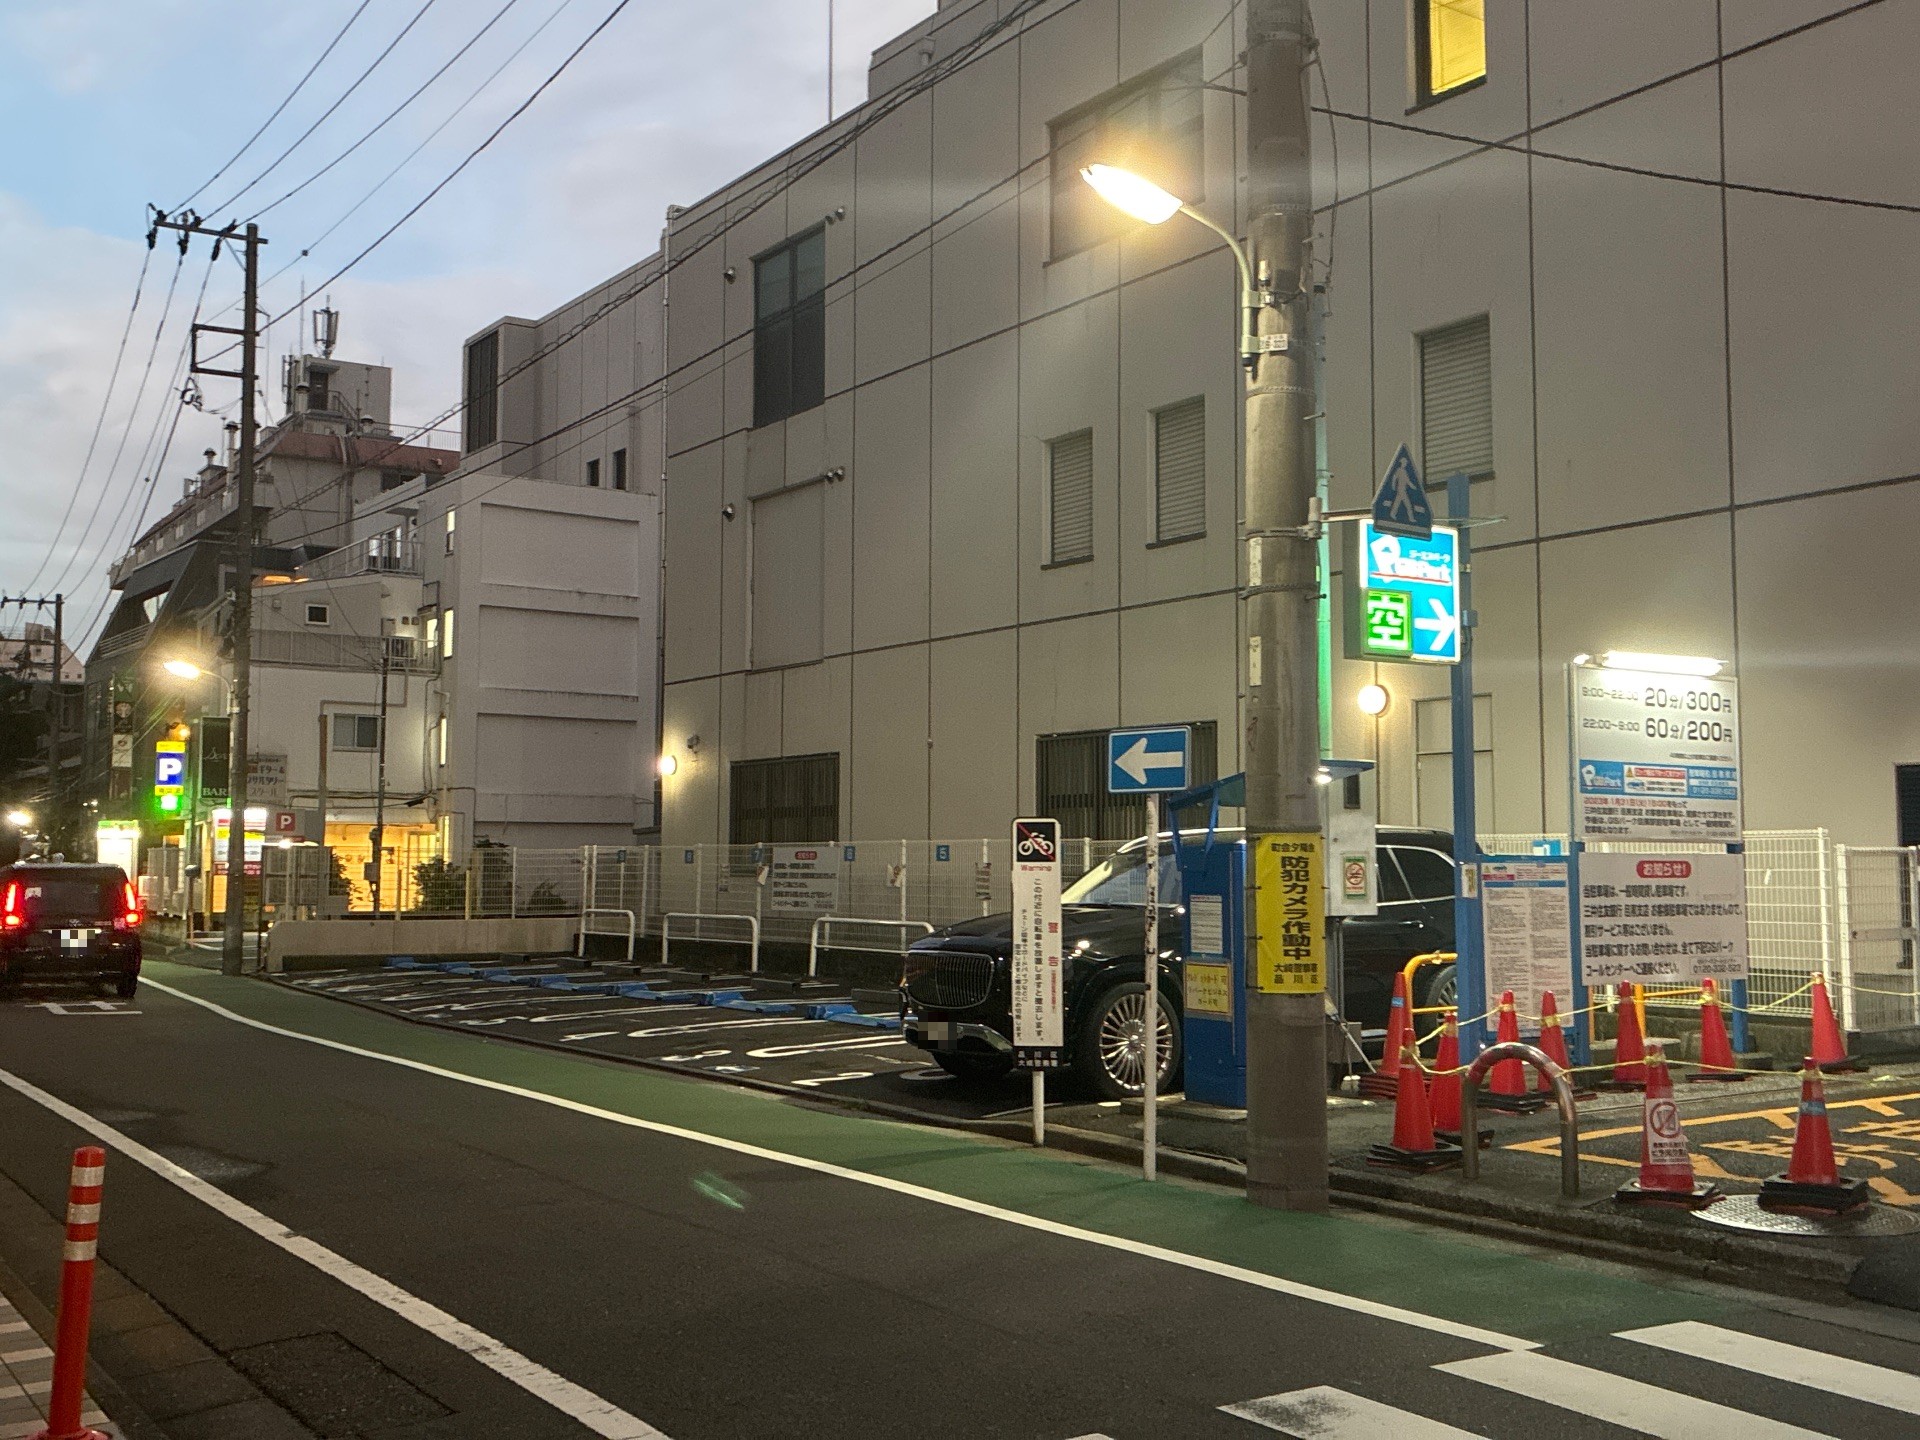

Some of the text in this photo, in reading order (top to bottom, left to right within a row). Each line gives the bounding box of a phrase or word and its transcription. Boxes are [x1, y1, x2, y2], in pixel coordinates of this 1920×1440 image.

[1367, 595, 1408, 650] 空
[159, 758, 182, 781] P
[202, 787, 227, 797] BAR
[280, 814, 293, 830] P
[1021, 864, 1053, 872] Warning
[1280, 855, 1311, 961] 防犯カメラ作動中
